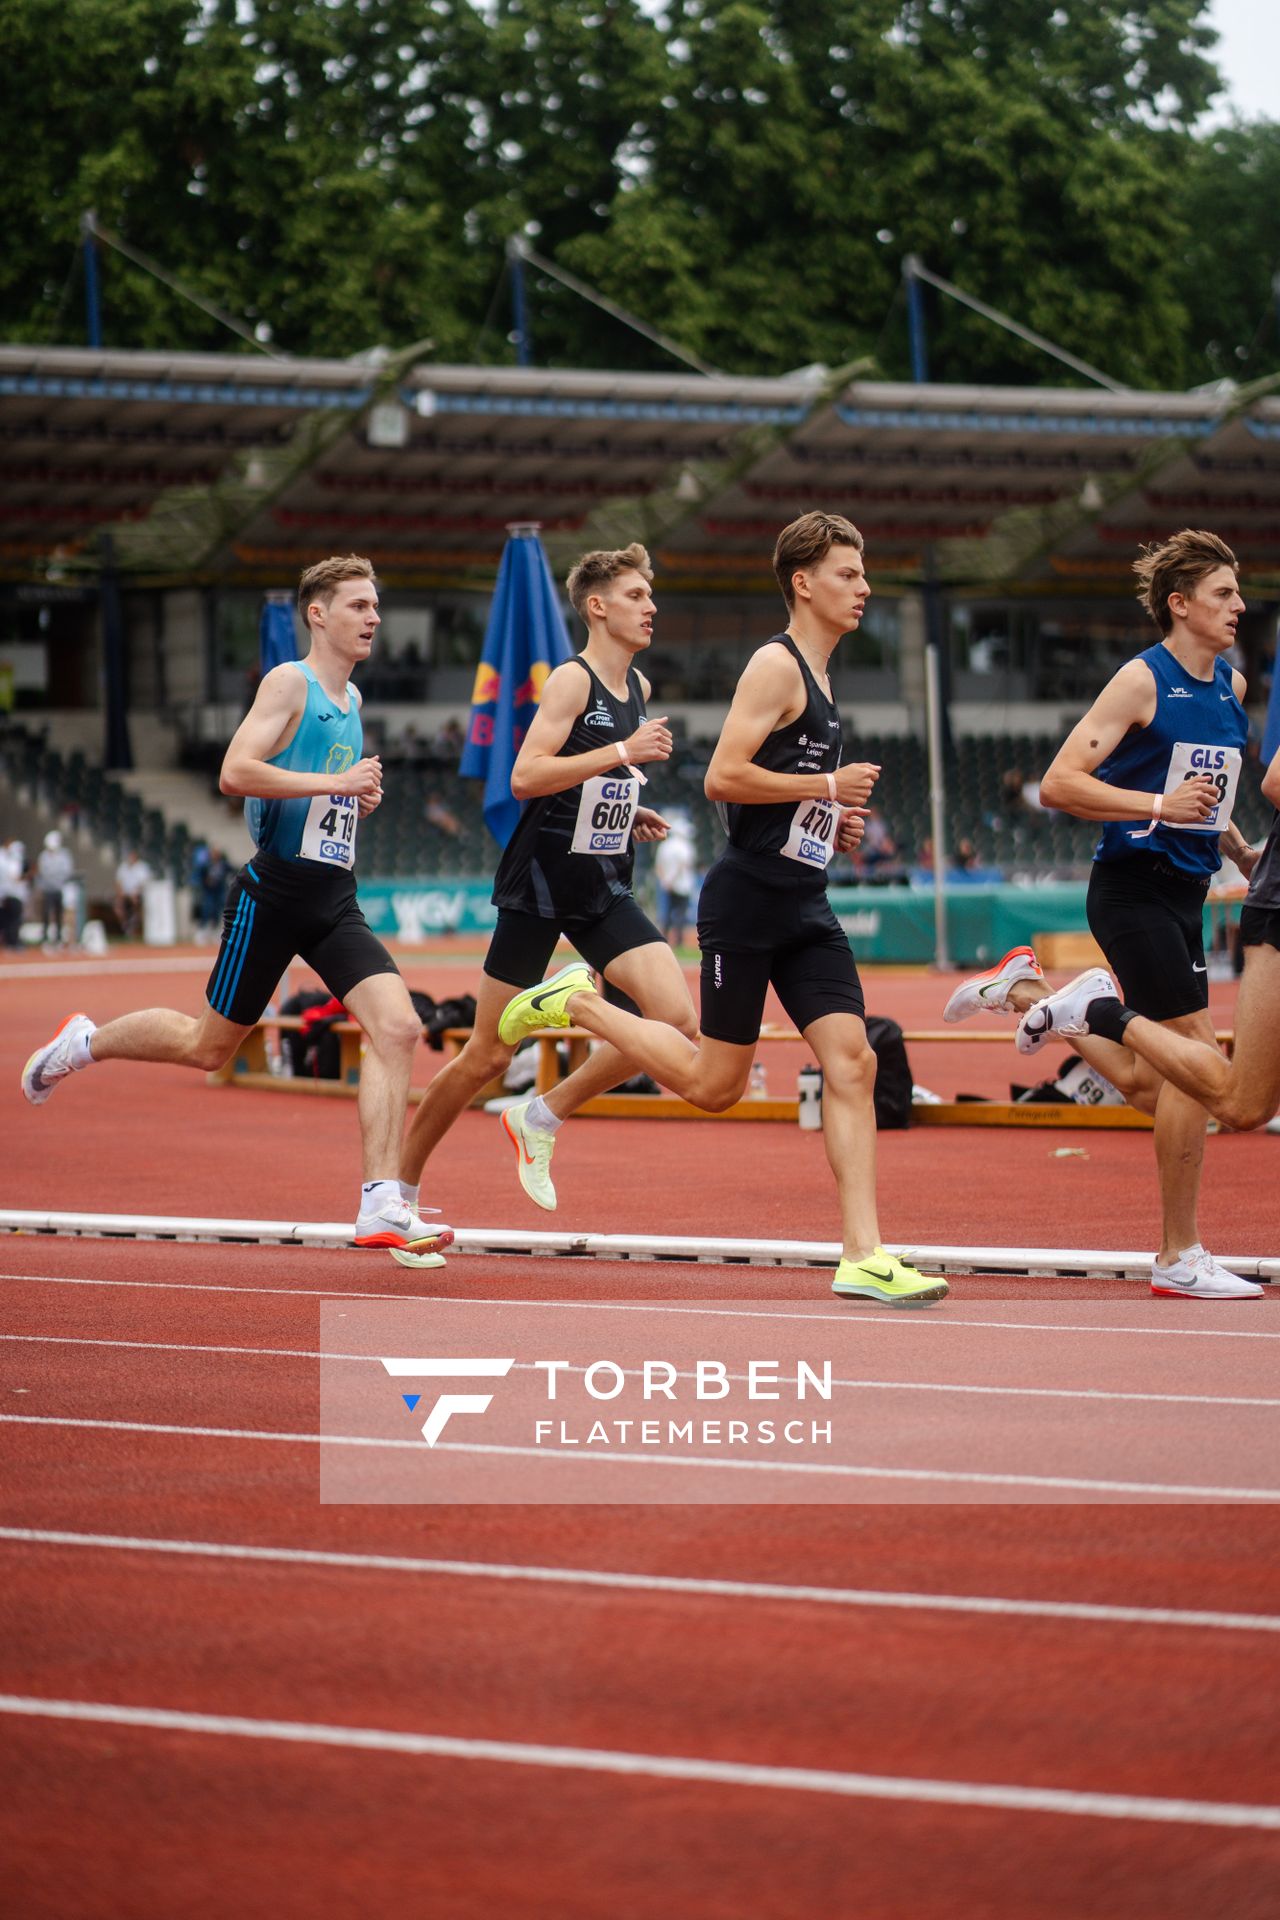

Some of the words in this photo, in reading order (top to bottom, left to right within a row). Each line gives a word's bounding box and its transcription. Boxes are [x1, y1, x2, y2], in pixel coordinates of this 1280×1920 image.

[319, 808, 355, 843] 419
[591, 802, 632, 831] 608
[800, 806, 833, 843] 470
[714, 954, 722, 982] CRAFT
